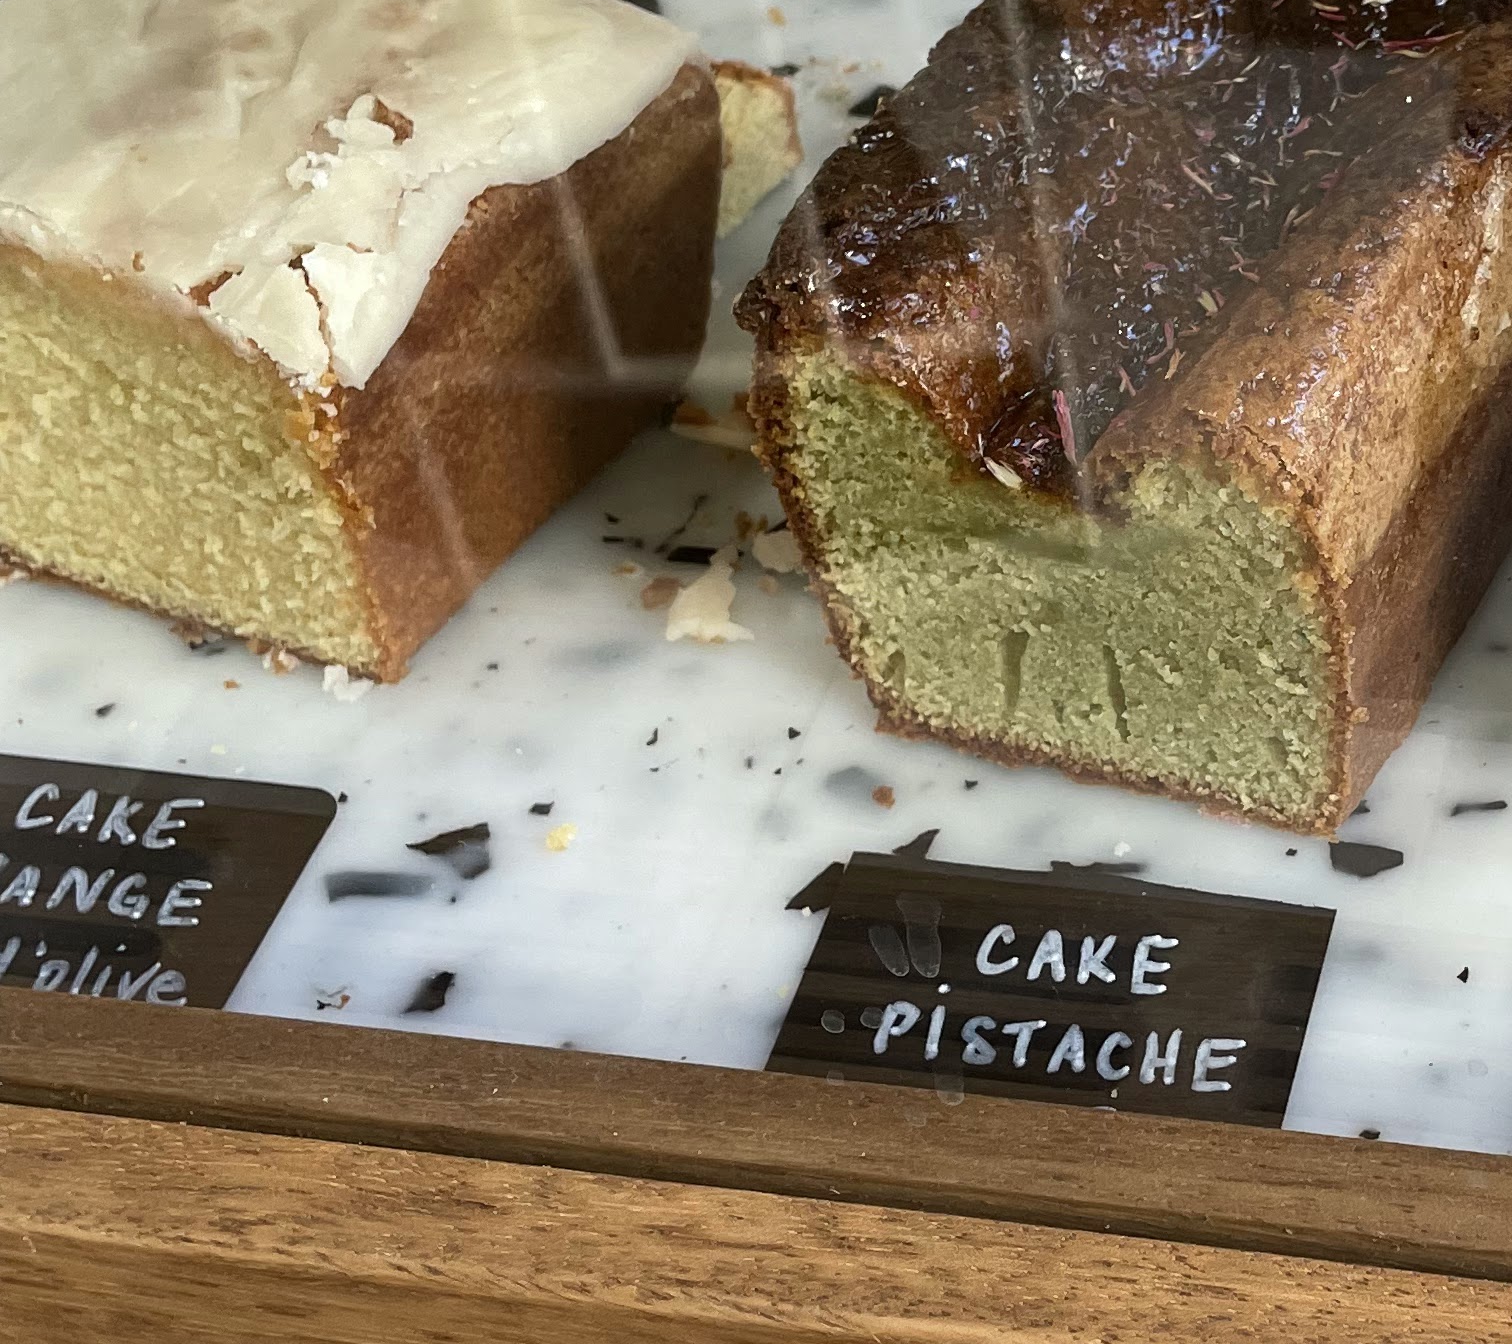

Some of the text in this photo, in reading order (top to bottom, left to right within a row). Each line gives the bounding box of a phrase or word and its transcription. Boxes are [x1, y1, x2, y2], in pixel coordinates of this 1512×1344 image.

[14, 781, 206, 850] CAKE
[0, 851, 213, 927] ANGE
[975, 923, 1180, 995] CAKE
